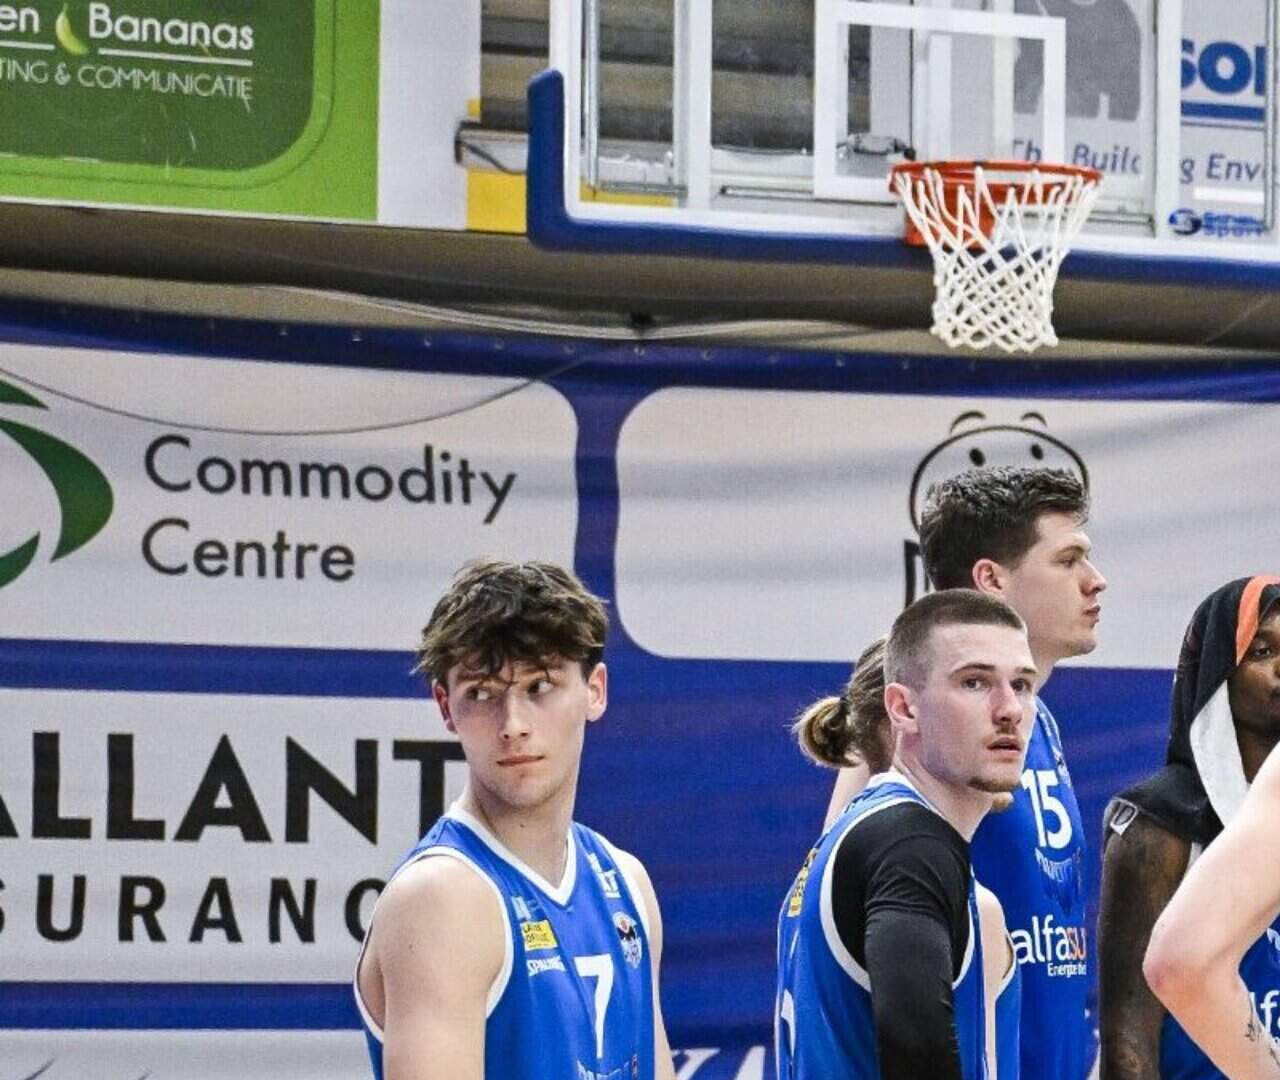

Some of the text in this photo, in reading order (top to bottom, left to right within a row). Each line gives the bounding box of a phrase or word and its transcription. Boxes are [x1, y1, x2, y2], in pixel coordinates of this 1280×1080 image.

[89, 2, 254, 50] Bananas
[54, 63, 71, 85] &
[77, 65, 253, 99] COMMUNICATIE
[144, 434, 518, 525] Commodity
[142, 518, 355, 582] Centre
[1020, 769, 1073, 849] 15
[572, 954, 614, 1059] 7
